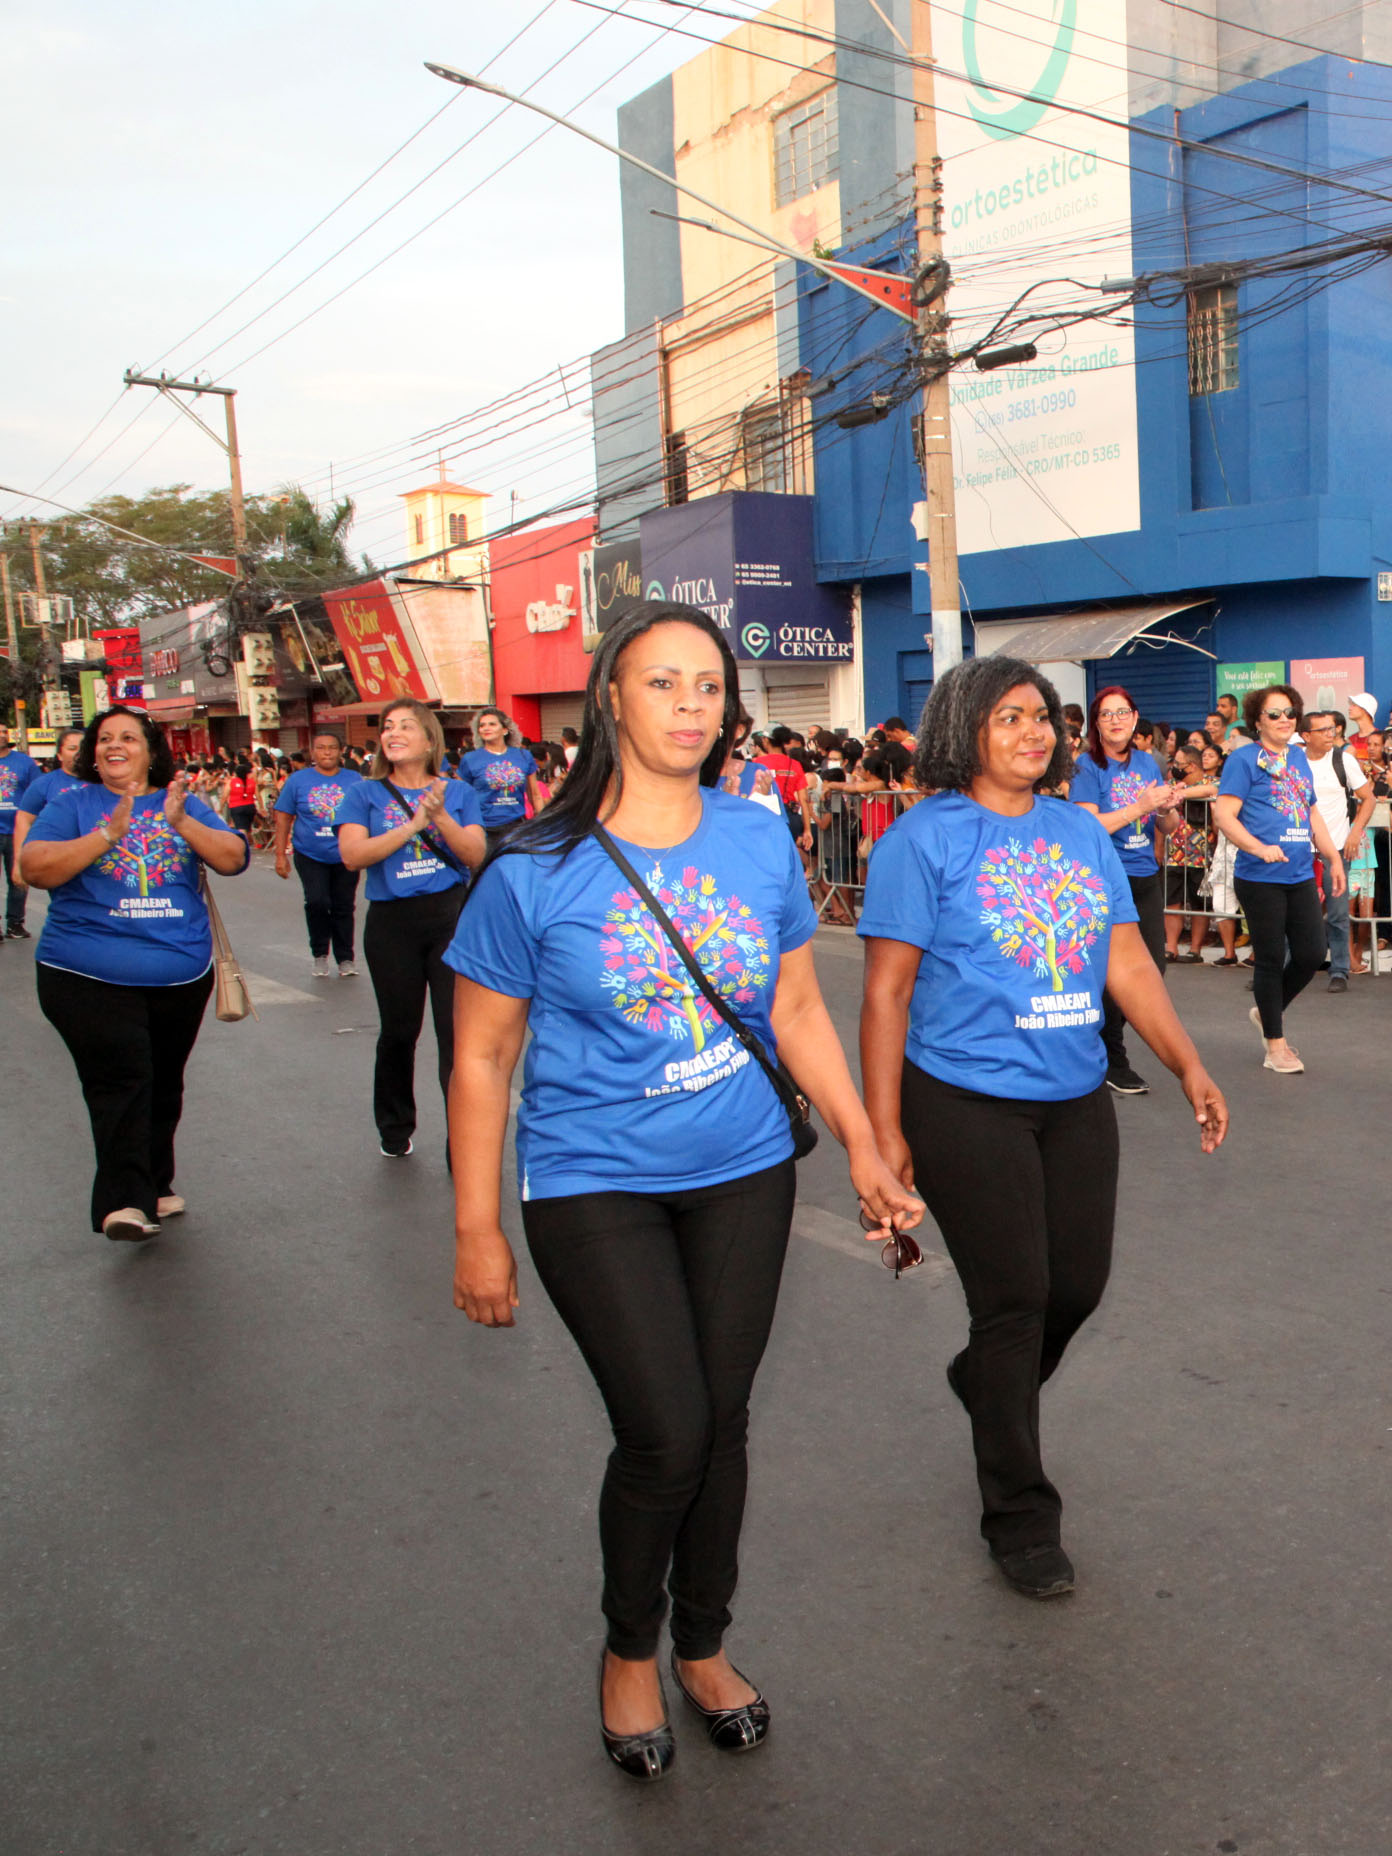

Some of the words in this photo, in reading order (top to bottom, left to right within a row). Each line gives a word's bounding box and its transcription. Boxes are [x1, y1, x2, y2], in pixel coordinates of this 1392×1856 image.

[951, 148, 1097, 229] ortoestética
[1061, 344, 1119, 377] Grande
[1007, 388, 1076, 423] 3681-0990
[966, 471, 993, 489] Felipe
[1026, 449, 1090, 476] CRO/MT-CD
[1092, 443, 1121, 463] 5365
[672, 575, 718, 605] ÓTICA
[779, 622, 835, 642] ÓTICA
[120, 898, 172, 909] CMAEAPI
[131, 909, 165, 919] Ribeiro
[165, 908, 184, 918] Filho
[1030, 991, 1092, 1014] CMAEAPI
[1014, 1014, 1046, 1030] João
[1047, 1012, 1085, 1029] Ribeiro
[682, 1064, 732, 1093] Ribeiro
